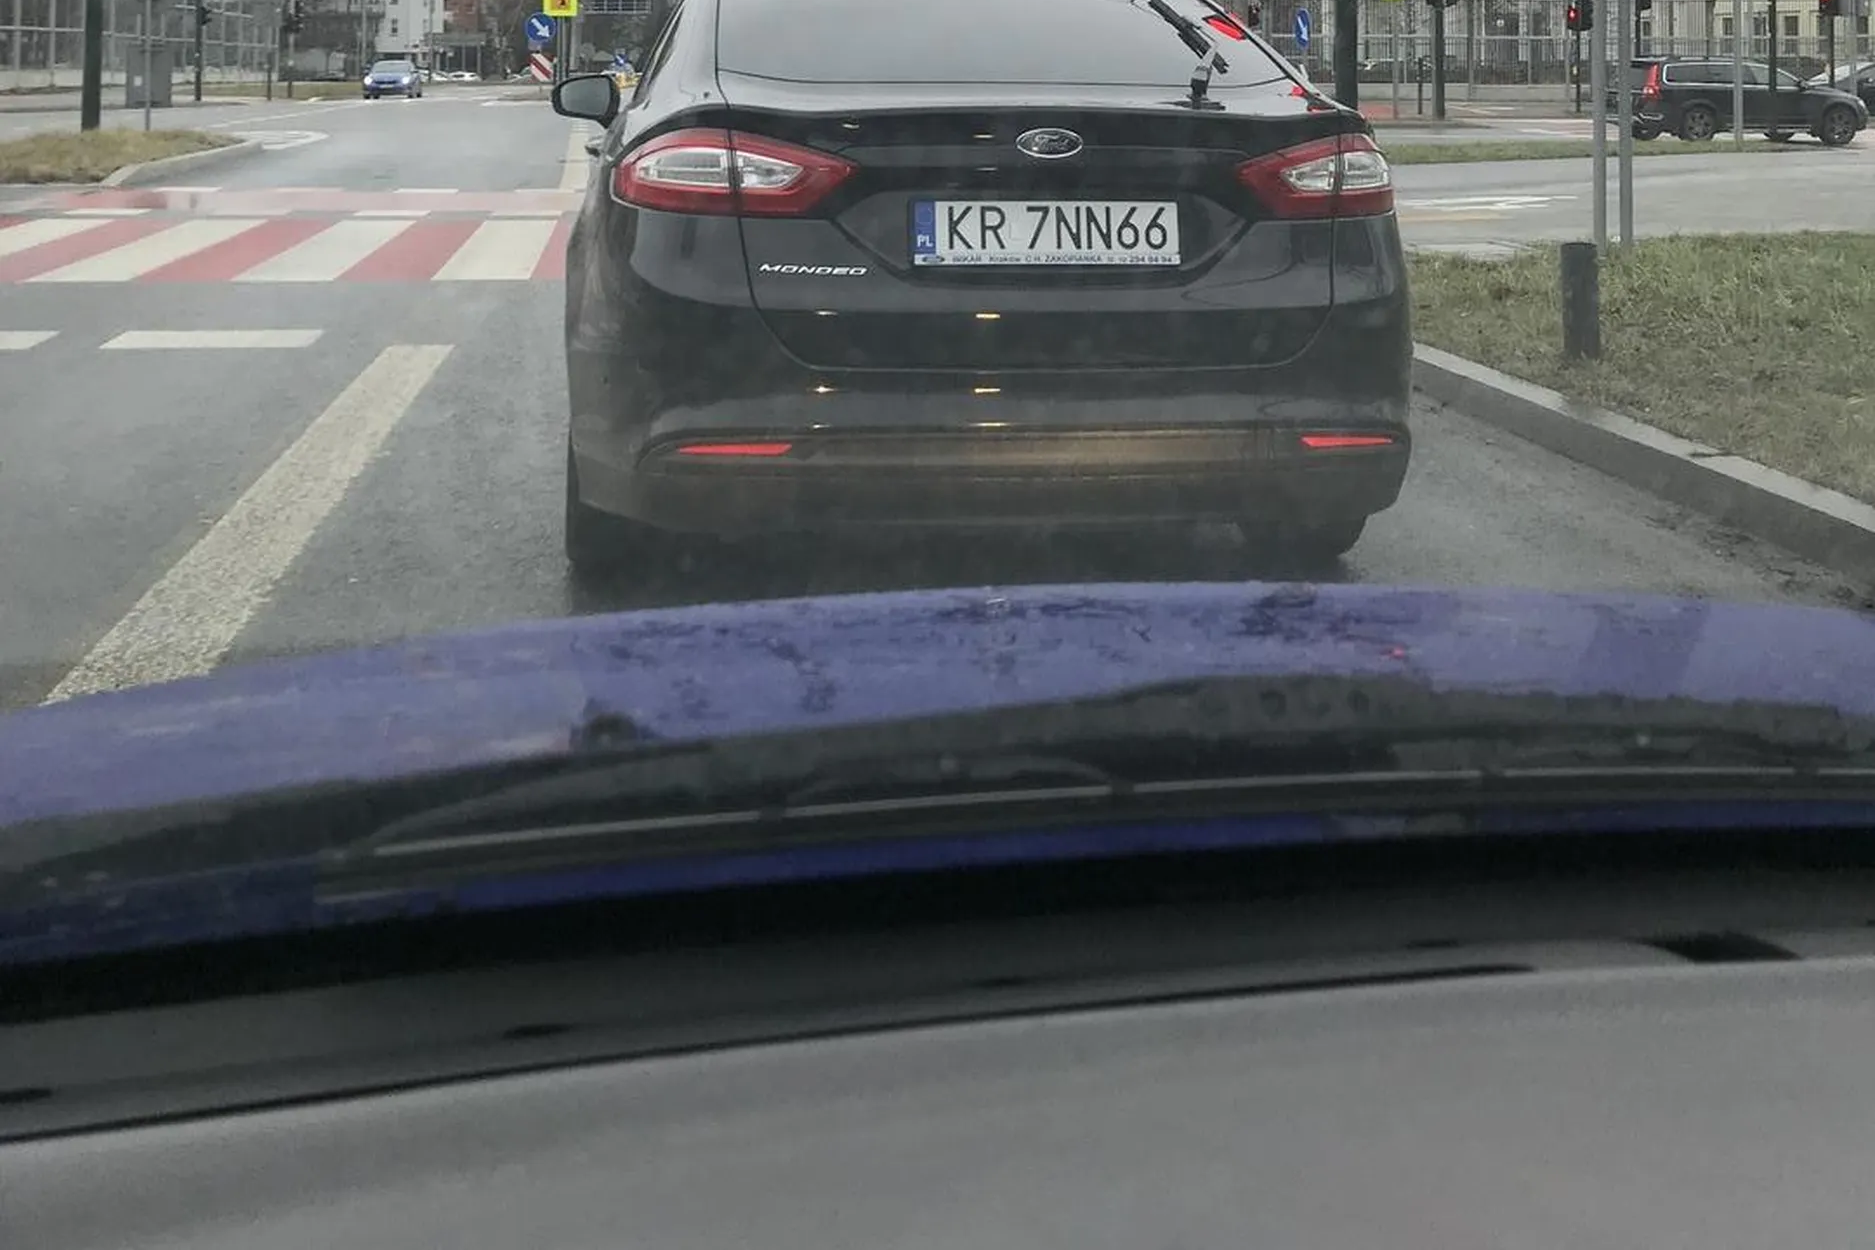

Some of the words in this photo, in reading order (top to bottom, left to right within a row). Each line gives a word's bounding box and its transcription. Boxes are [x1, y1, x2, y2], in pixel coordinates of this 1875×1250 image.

[948, 205, 1005, 251] KR
[1026, 205, 1168, 250] 7NN66
[917, 234, 934, 248] PL
[759, 263, 868, 276] MONDEO
